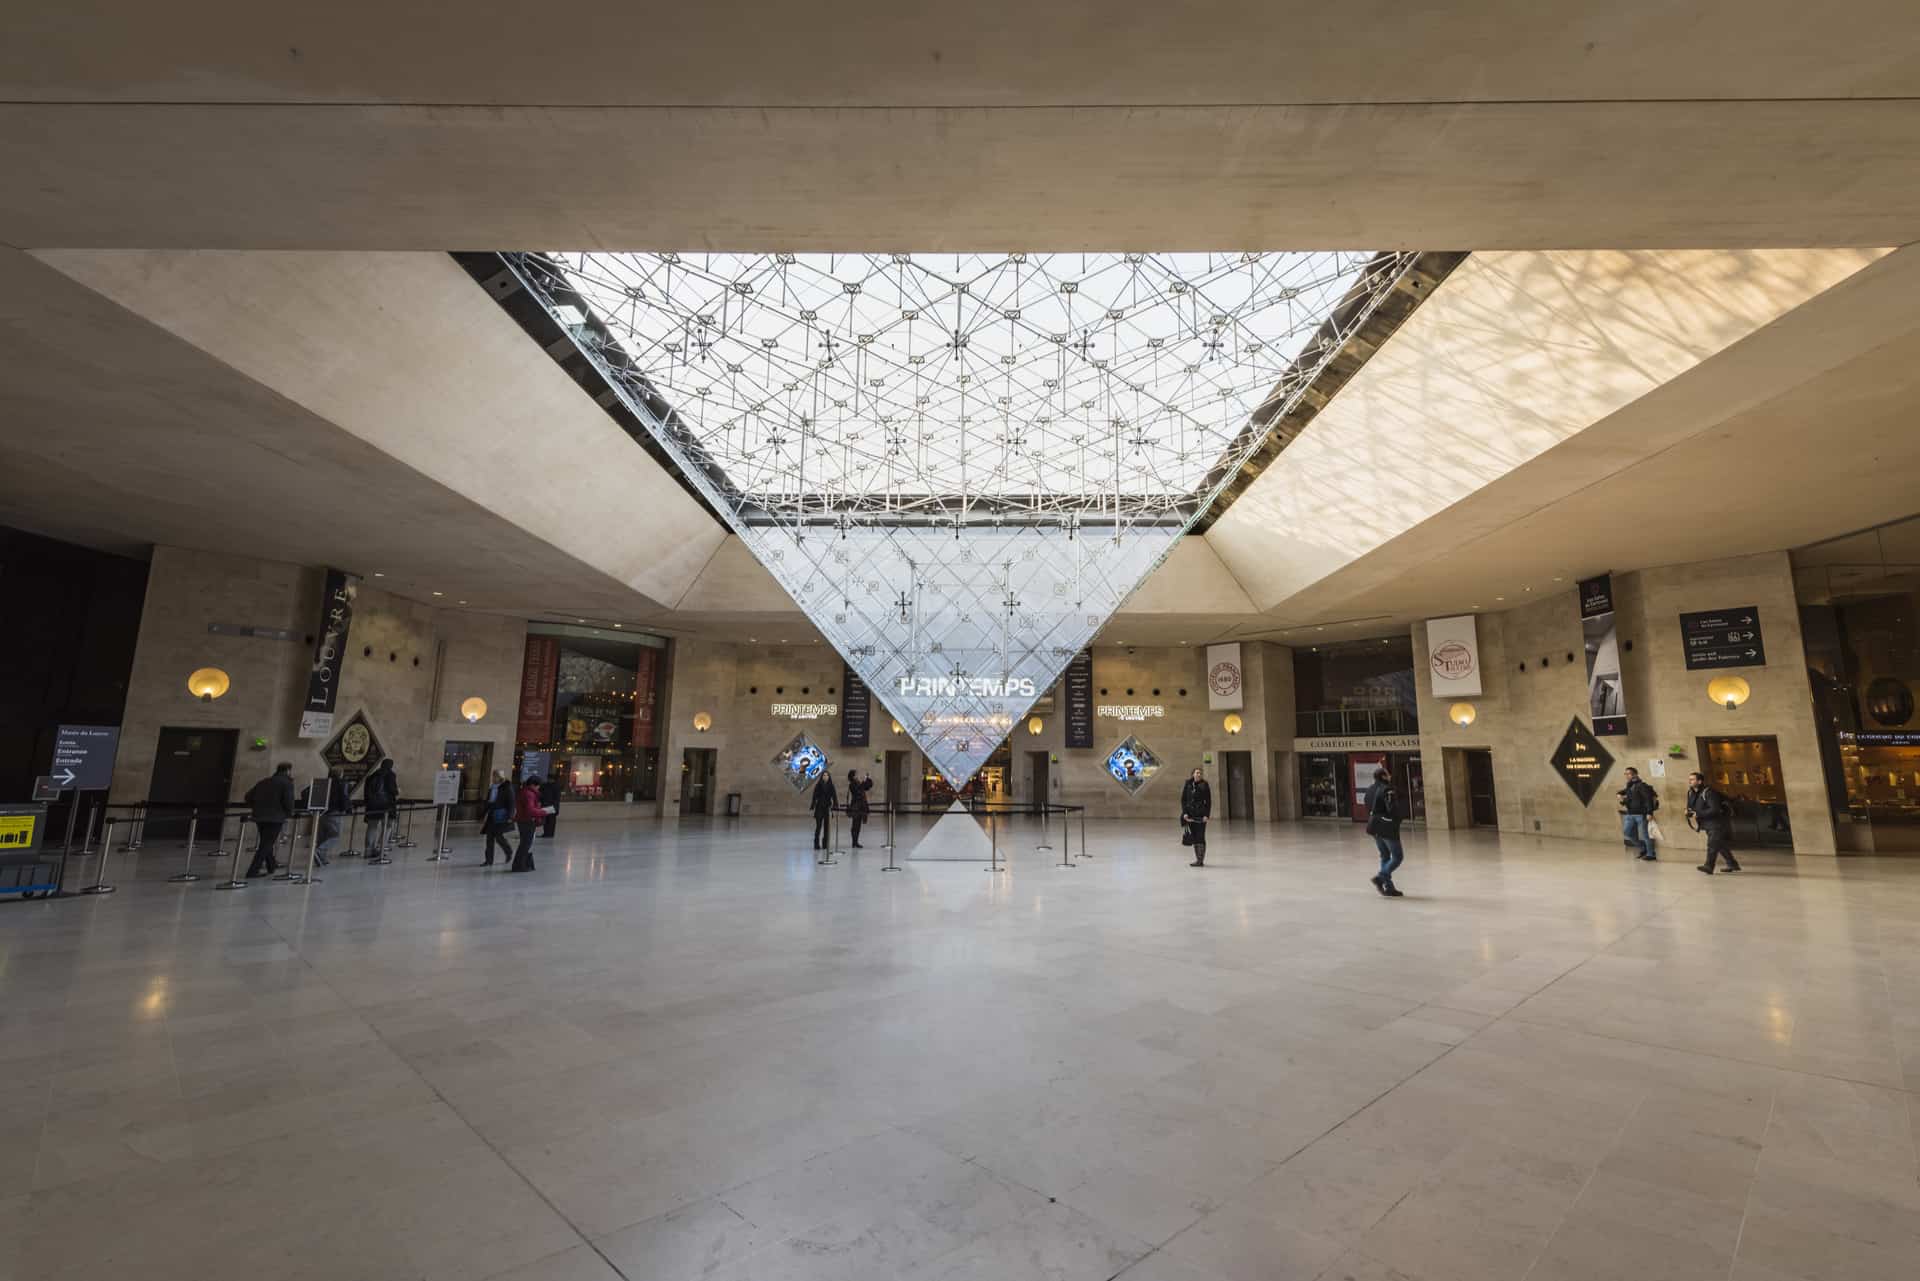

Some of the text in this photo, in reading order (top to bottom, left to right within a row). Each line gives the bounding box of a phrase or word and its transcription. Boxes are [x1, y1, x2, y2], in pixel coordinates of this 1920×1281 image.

[311, 588, 348, 705] LOUVRE
[899, 677, 1036, 697] PRINTEMPS
[770, 703, 838, 715] PRINTEMPS
[1097, 705, 1165, 717] PRINTEMPS
